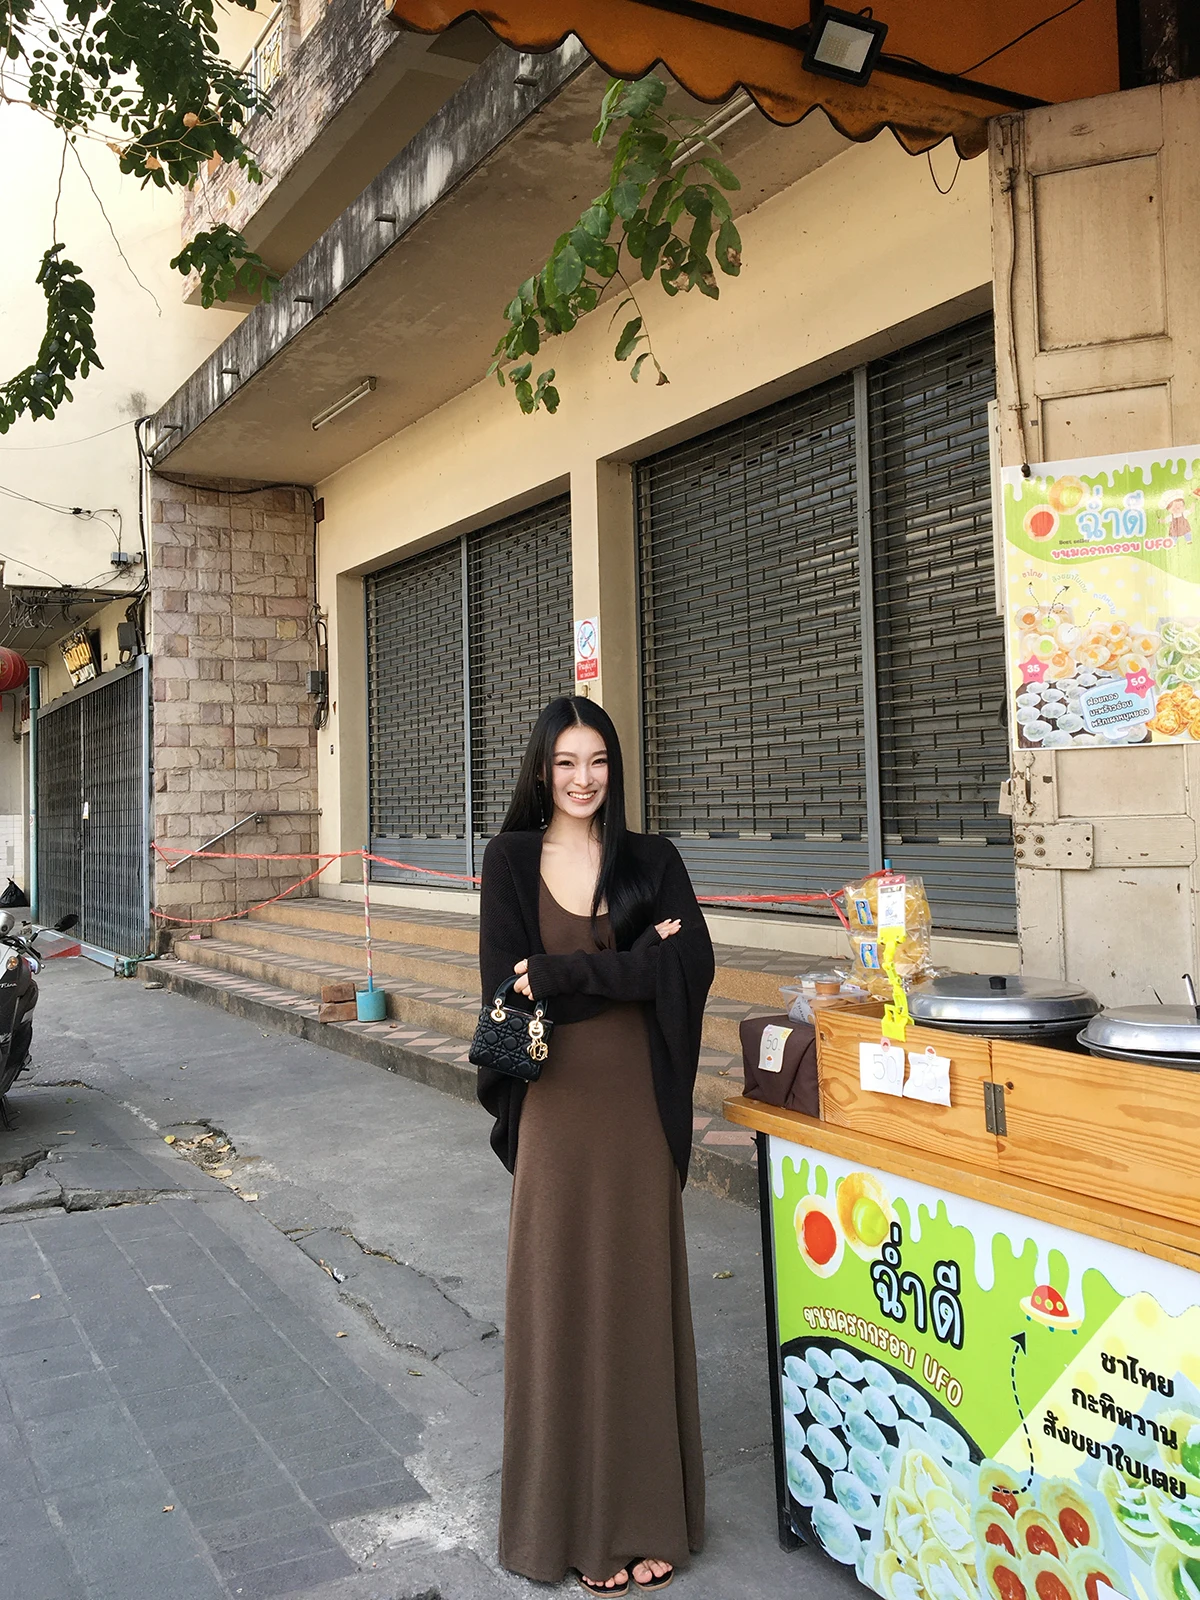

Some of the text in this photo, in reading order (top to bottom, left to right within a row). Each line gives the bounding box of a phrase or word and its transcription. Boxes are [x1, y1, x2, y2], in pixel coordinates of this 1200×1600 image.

[1077, 486, 1145, 541] ฉ่ำดี
[1052, 538, 1174, 559] ขนมครกกรอบ UFO
[1027, 664, 1041, 673] 35
[1130, 675, 1146, 686] 50
[1086, 692, 1119, 706] ฝอยทอง
[870, 1221, 964, 1350] ฉ่ำดี
[803, 1306, 963, 1407] ขนมครกกรอบ UFO
[1100, 1351, 1175, 1398] ชาไทย
[1071, 1387, 1178, 1450] กะทิหวาน
[1043, 1410, 1187, 1499] สังขยาใบเตย
